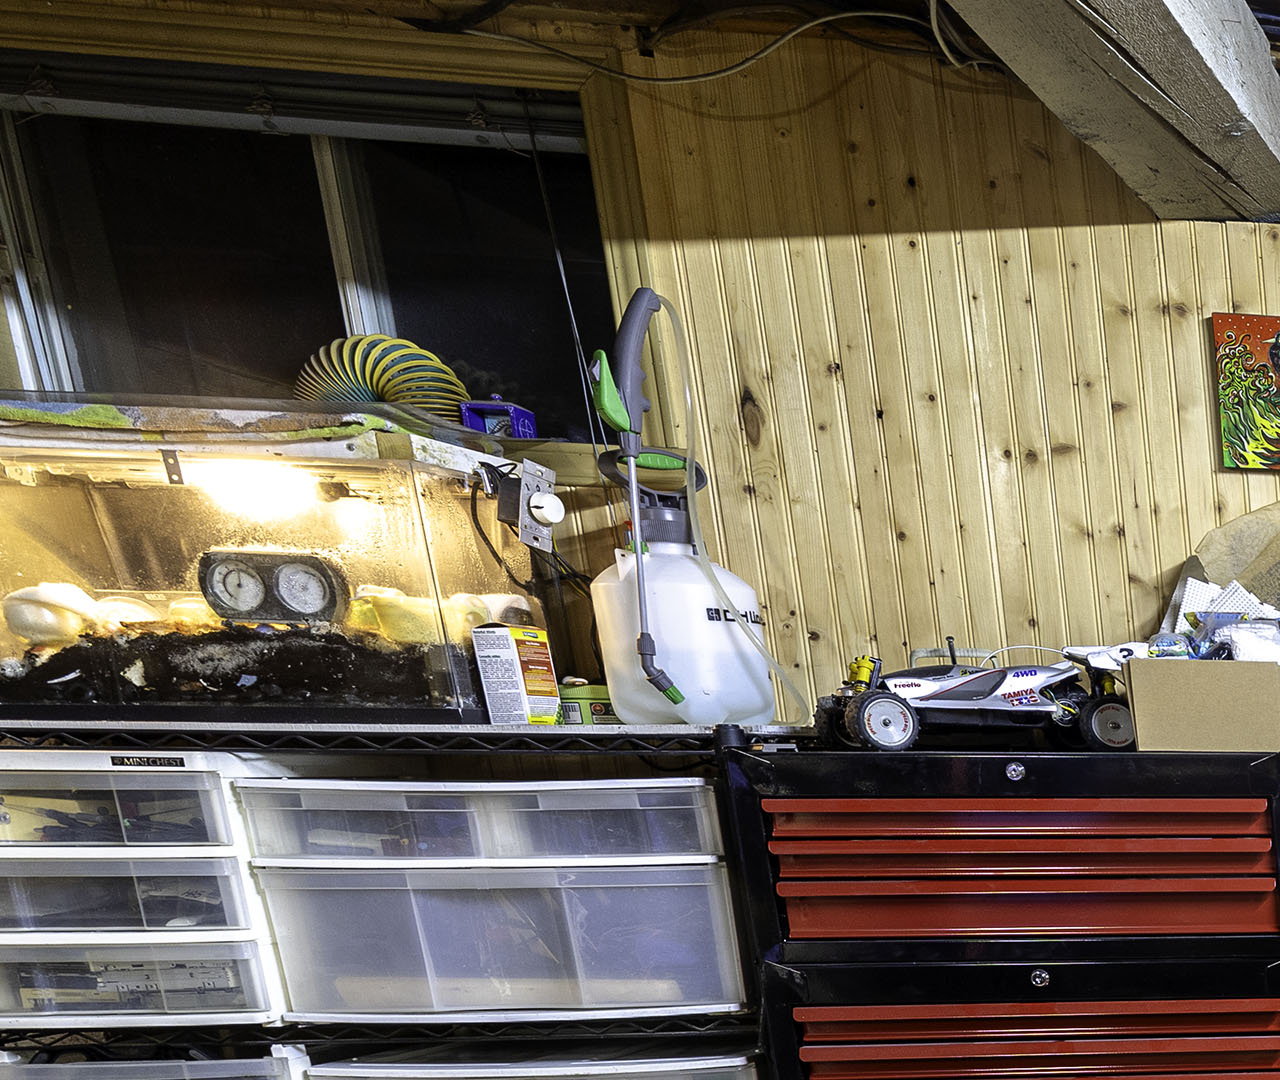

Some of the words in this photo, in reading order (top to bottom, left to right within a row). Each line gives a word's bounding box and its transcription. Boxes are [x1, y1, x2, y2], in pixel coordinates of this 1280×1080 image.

[1012, 670, 1038, 678] 4WD
[1001, 688, 1035, 700] TAMIYA
[123, 757, 148, 766] MINI
[149, 758, 181, 766] CHEST
